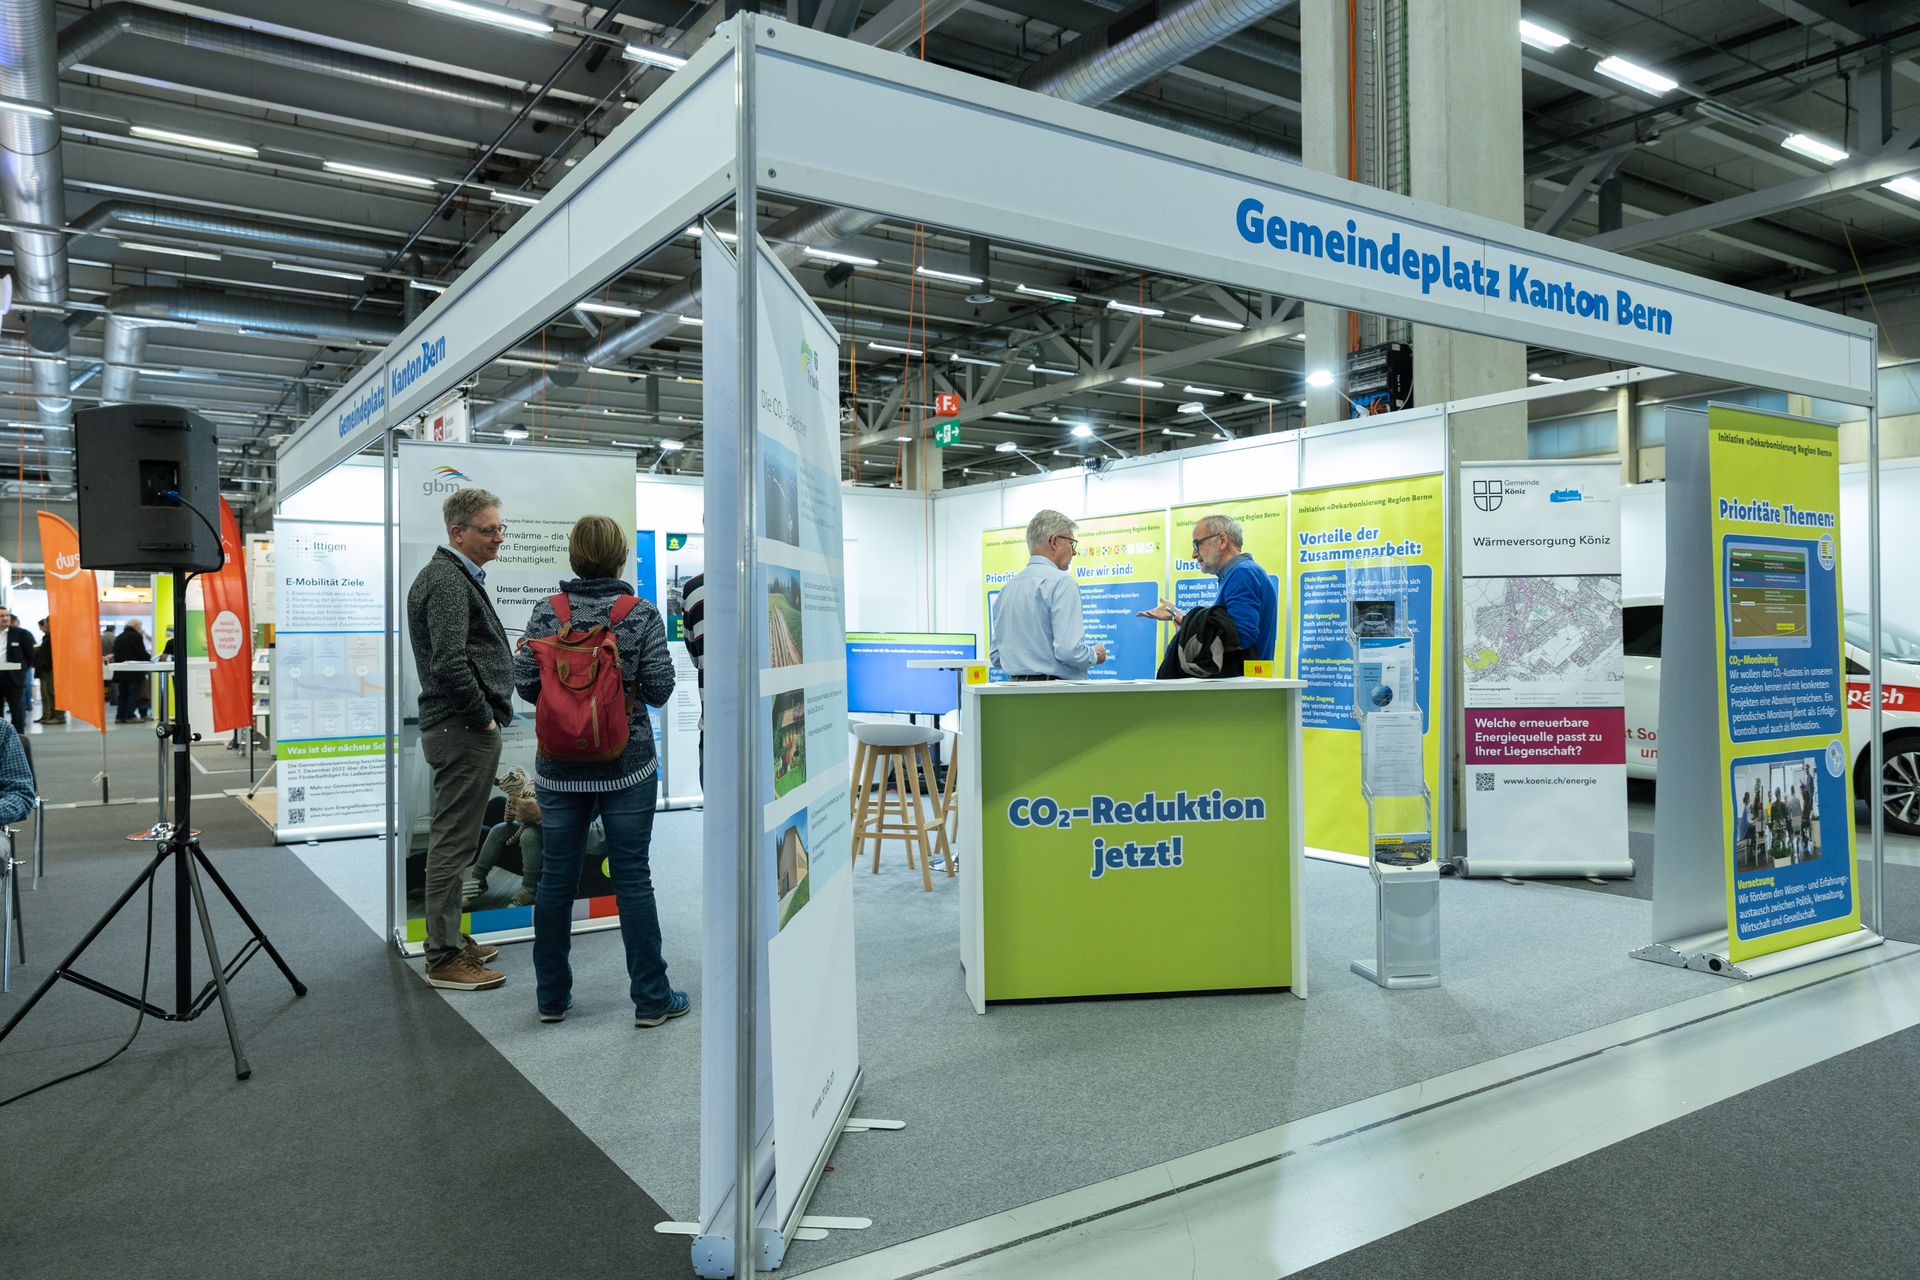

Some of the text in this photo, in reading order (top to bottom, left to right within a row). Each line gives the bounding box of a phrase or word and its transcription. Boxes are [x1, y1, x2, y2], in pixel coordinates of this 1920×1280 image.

[1236, 198, 1672, 335] Gemeindeplatz Kanton Bern
[339, 336, 445, 438] Gemeindeplatz Kanton Bern
[943, 395, 952, 411] F
[1718, 433, 1745, 445] Initiative
[1746, 437, 1797, 455] «Dekarbonisierung
[1798, 445, 1816, 456] Region
[423, 479, 460, 496] gbm
[1298, 506, 1325, 514] Initiative
[1327, 499, 1386, 511] «Dekarbonisierung
[1387, 496, 1411, 505] Region
[1719, 498, 1834, 527] Prioritäre Themen:
[1299, 527, 1379, 546] Vorteile der
[1473, 535, 1610, 548] Wärmeversorgung Köniz
[313, 541, 347, 552] Ittigen
[1300, 541, 1422, 563] Zusammenarbeit:
[496, 556, 557, 565] Nachhaltigkeit.
[1077, 563, 1133, 578] Wer wir sind:
[286, 577, 365, 587] E-Mobilität Ziele
[496, 585, 521, 593] Unser
[1729, 669, 1740, 679] Wir
[1741, 668, 1760, 679] wollen
[1761, 668, 1772, 678] den
[1804, 667, 1810, 676] in
[1811, 667, 1833, 676] unseren
[1730, 680, 1830, 694] Gemeinden kennen und mit konkreten
[1731, 692, 1834, 710] Projekten eine Absenkung erreichen. Ein
[1475, 717, 1590, 728] Welche erneuerbare
[1732, 706, 1838, 724] periodisches Monitoring dient als Erfolgs-
[1734, 725, 1758, 737] kontrolle
[1759, 723, 1770, 734] und
[1770, 723, 1783, 733] auch
[1791, 720, 1821, 731] Motivation.
[1475, 732, 1603, 745] Energiequelle passt zu
[288, 746, 307, 755] Was
[309, 746, 319, 754] ist
[321, 744, 336, 753] der
[338, 743, 371, 752] nächste
[1475, 745, 1582, 758] Ihrer Liegenschaft?
[1504, 777, 1597, 787] www.koeniz.ch/energie
[1009, 789, 1265, 828] CO2-Reduktion
[1091, 836, 1183, 878] jetzt!
[1738, 876, 1775, 889] Vernetzung
[1738, 875, 1849, 904] Wir fördern den Wissens- und Erfahrungs-
[1739, 890, 1845, 919] austausch zwischen Politik, Verwaltung,
[1740, 908, 1817, 933] Wirtschaft und Gesellschaft.
